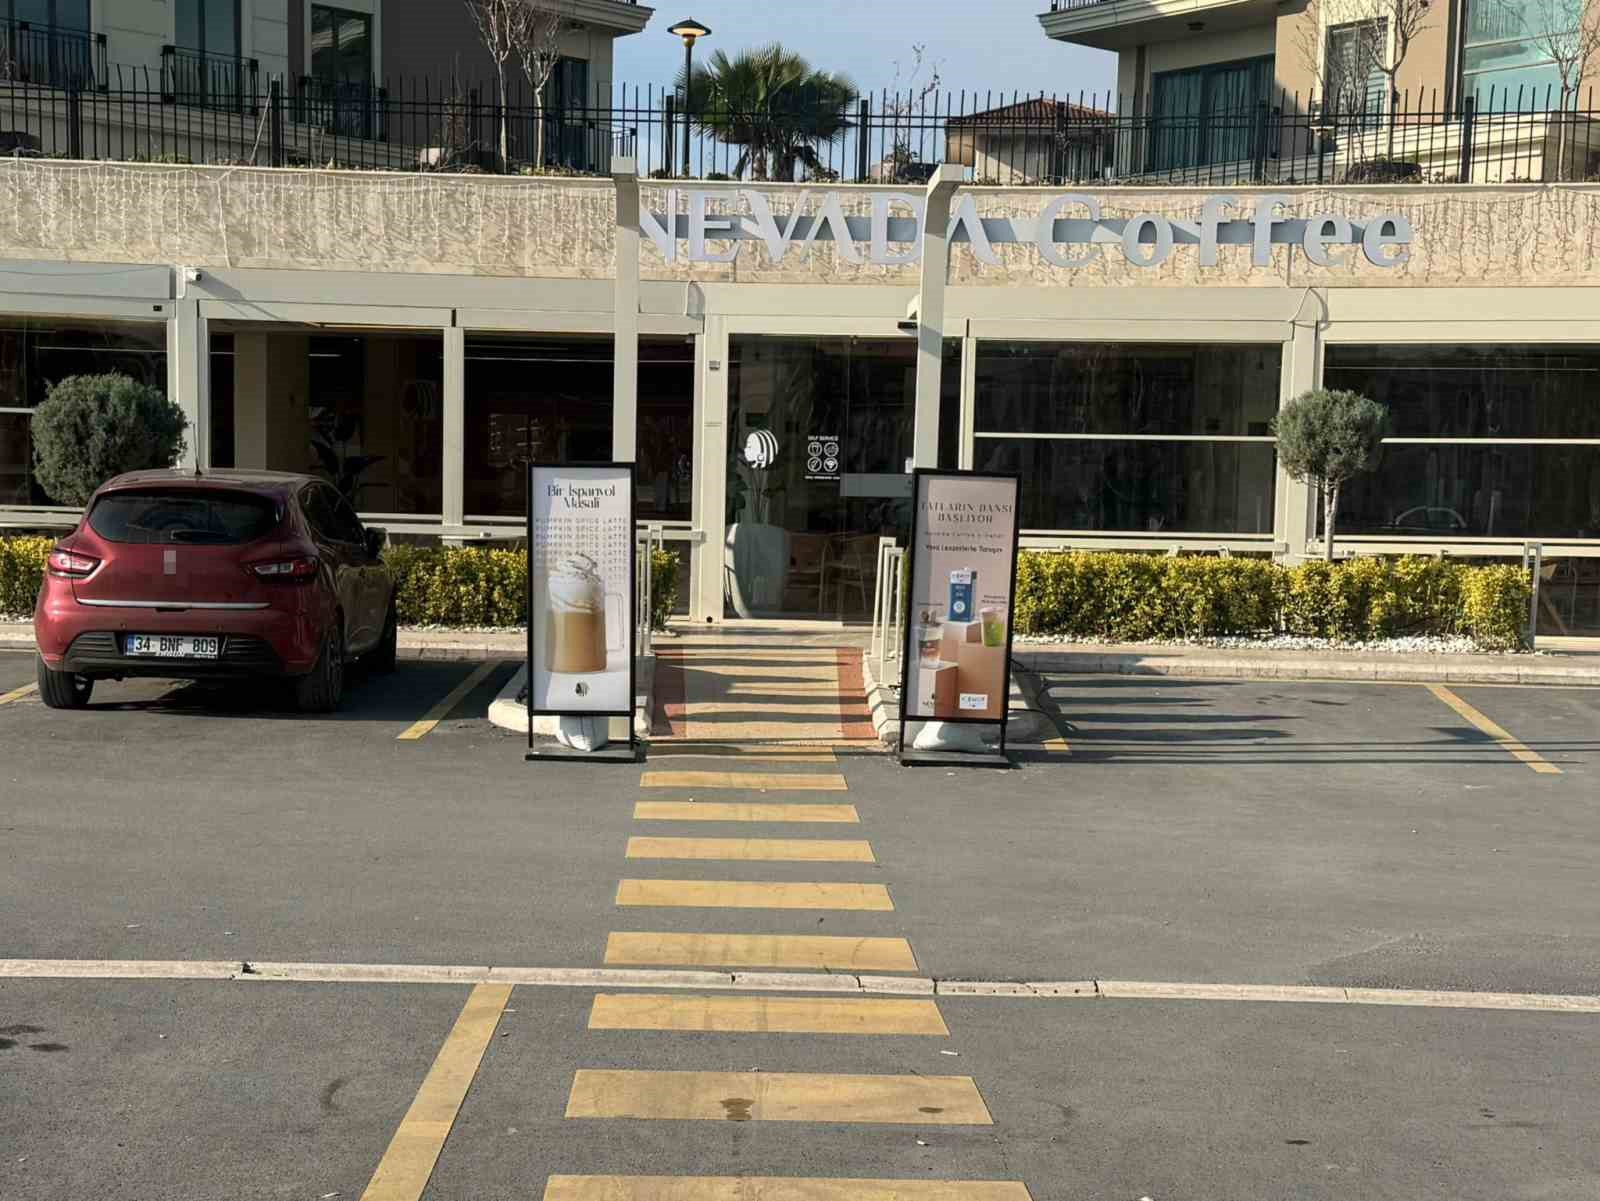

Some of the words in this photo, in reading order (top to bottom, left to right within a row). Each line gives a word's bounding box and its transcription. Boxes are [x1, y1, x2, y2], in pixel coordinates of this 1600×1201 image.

[639, 189, 1004, 265] NEVADA
[1039, 193, 1412, 267] Coffee
[135, 636, 151, 651] 34
[160, 637, 184, 652] BNF
[192, 638, 217, 653] 809
